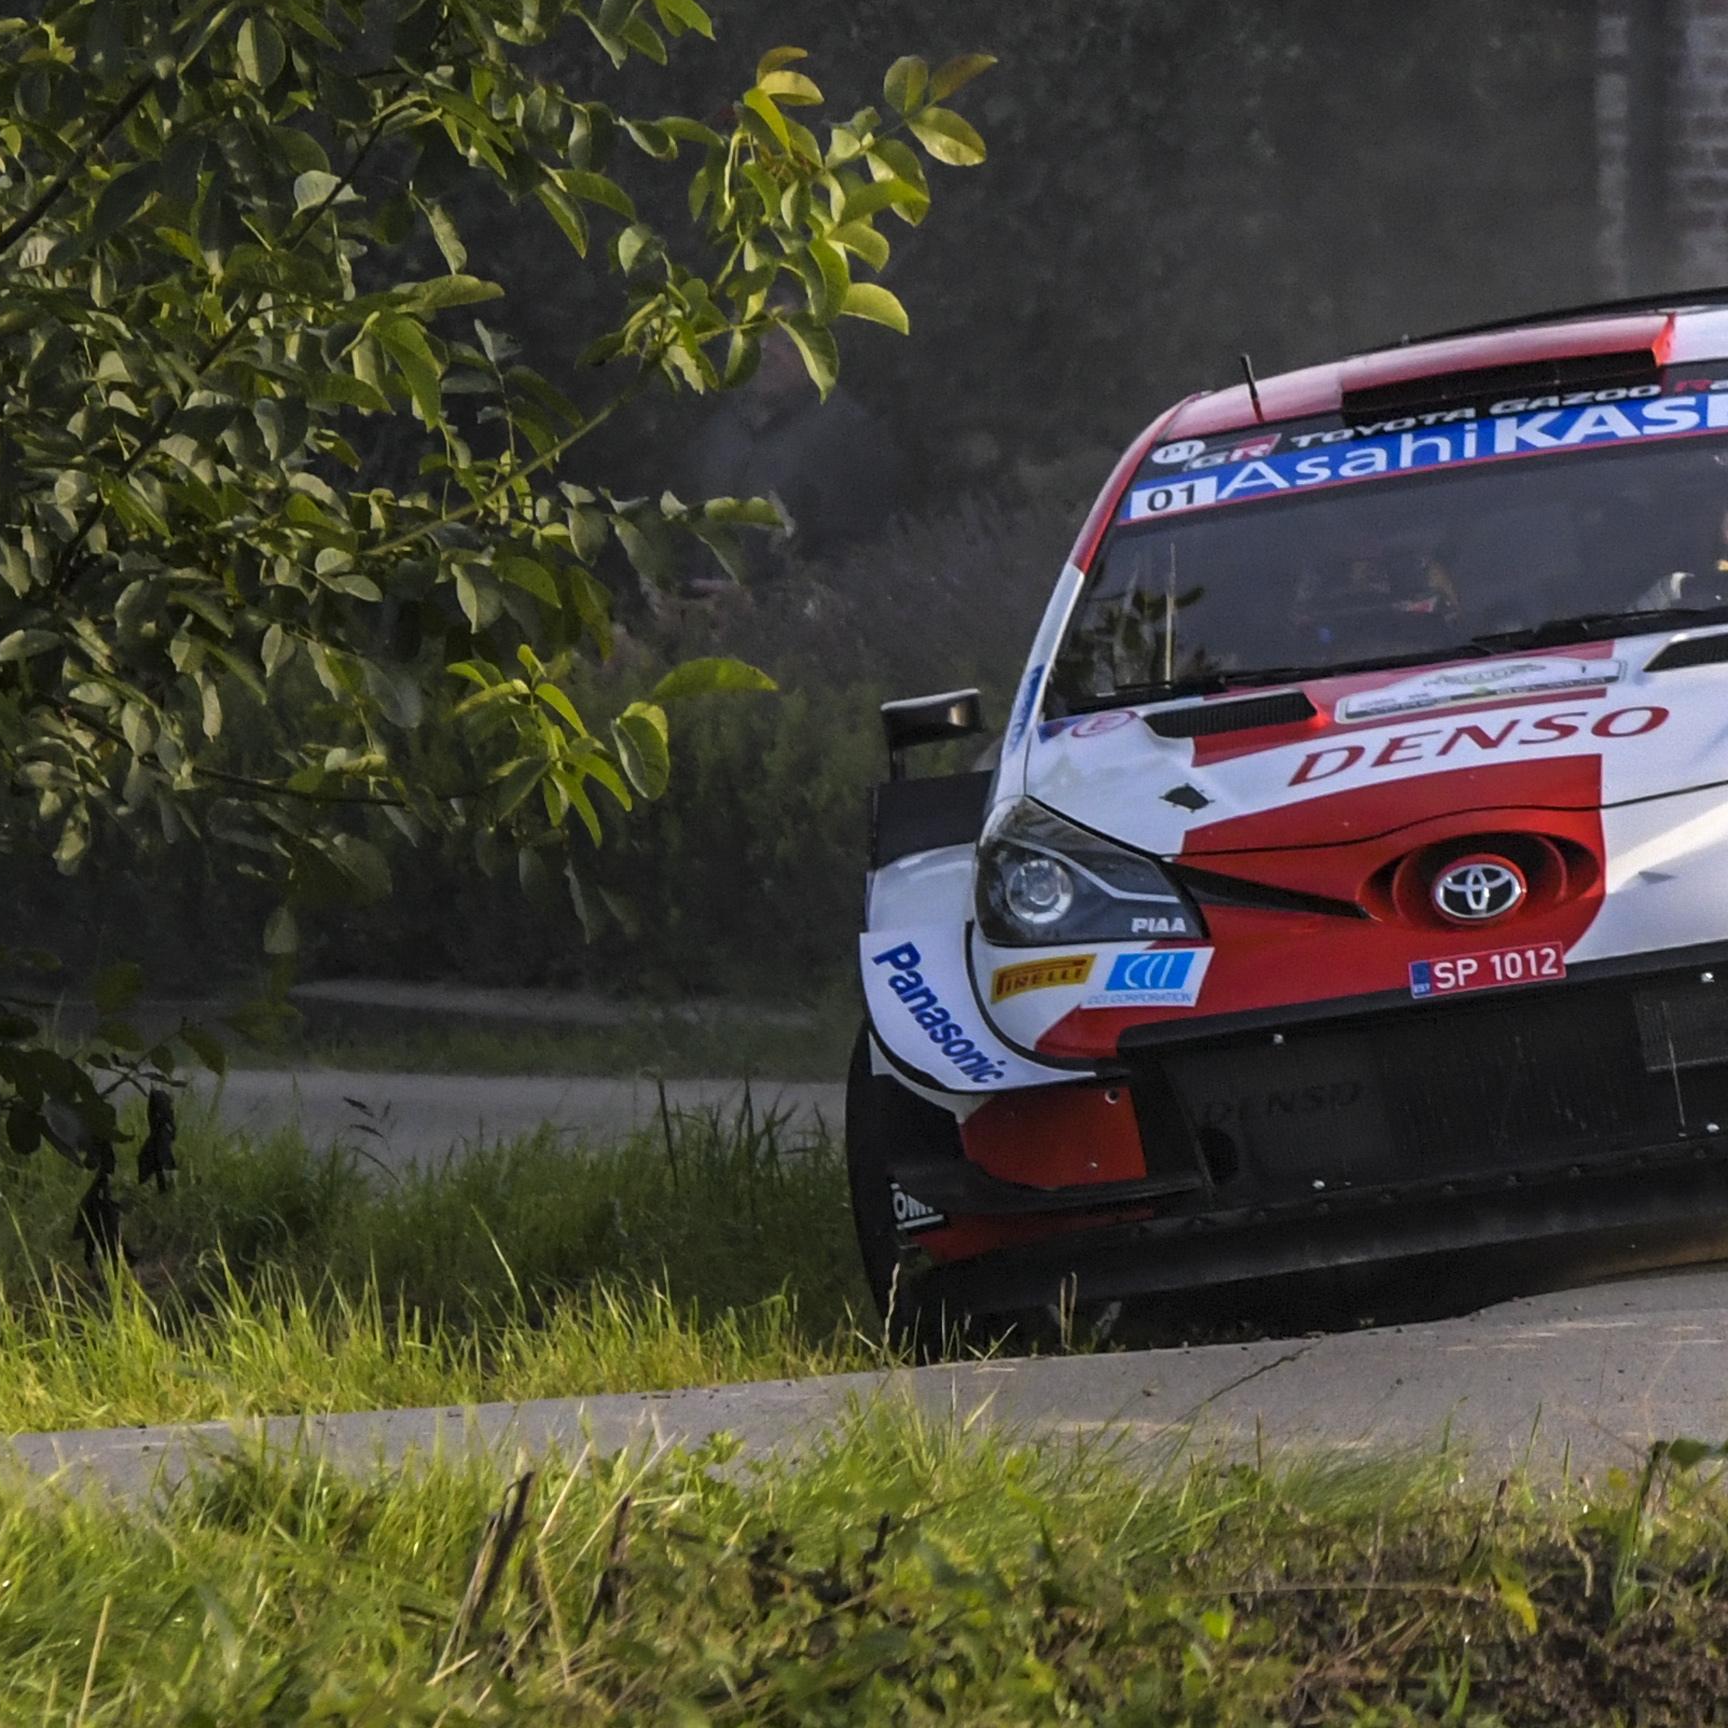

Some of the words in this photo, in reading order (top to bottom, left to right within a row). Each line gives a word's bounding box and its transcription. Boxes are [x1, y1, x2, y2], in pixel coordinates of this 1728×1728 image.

[1290, 407, 1476, 448] TOYOTA
[1489, 384, 1661, 415] GAZOO
[1146, 484, 1196, 512] 01
[1288, 705, 1669, 787] DENSO
[1131, 917, 1187, 933] PIAA
[997, 959, 1087, 996] PIRELLI
[1433, 958, 1478, 989] SP
[1490, 947, 1559, 981] 1012
[872, 941, 1006, 1084] Panasonic
